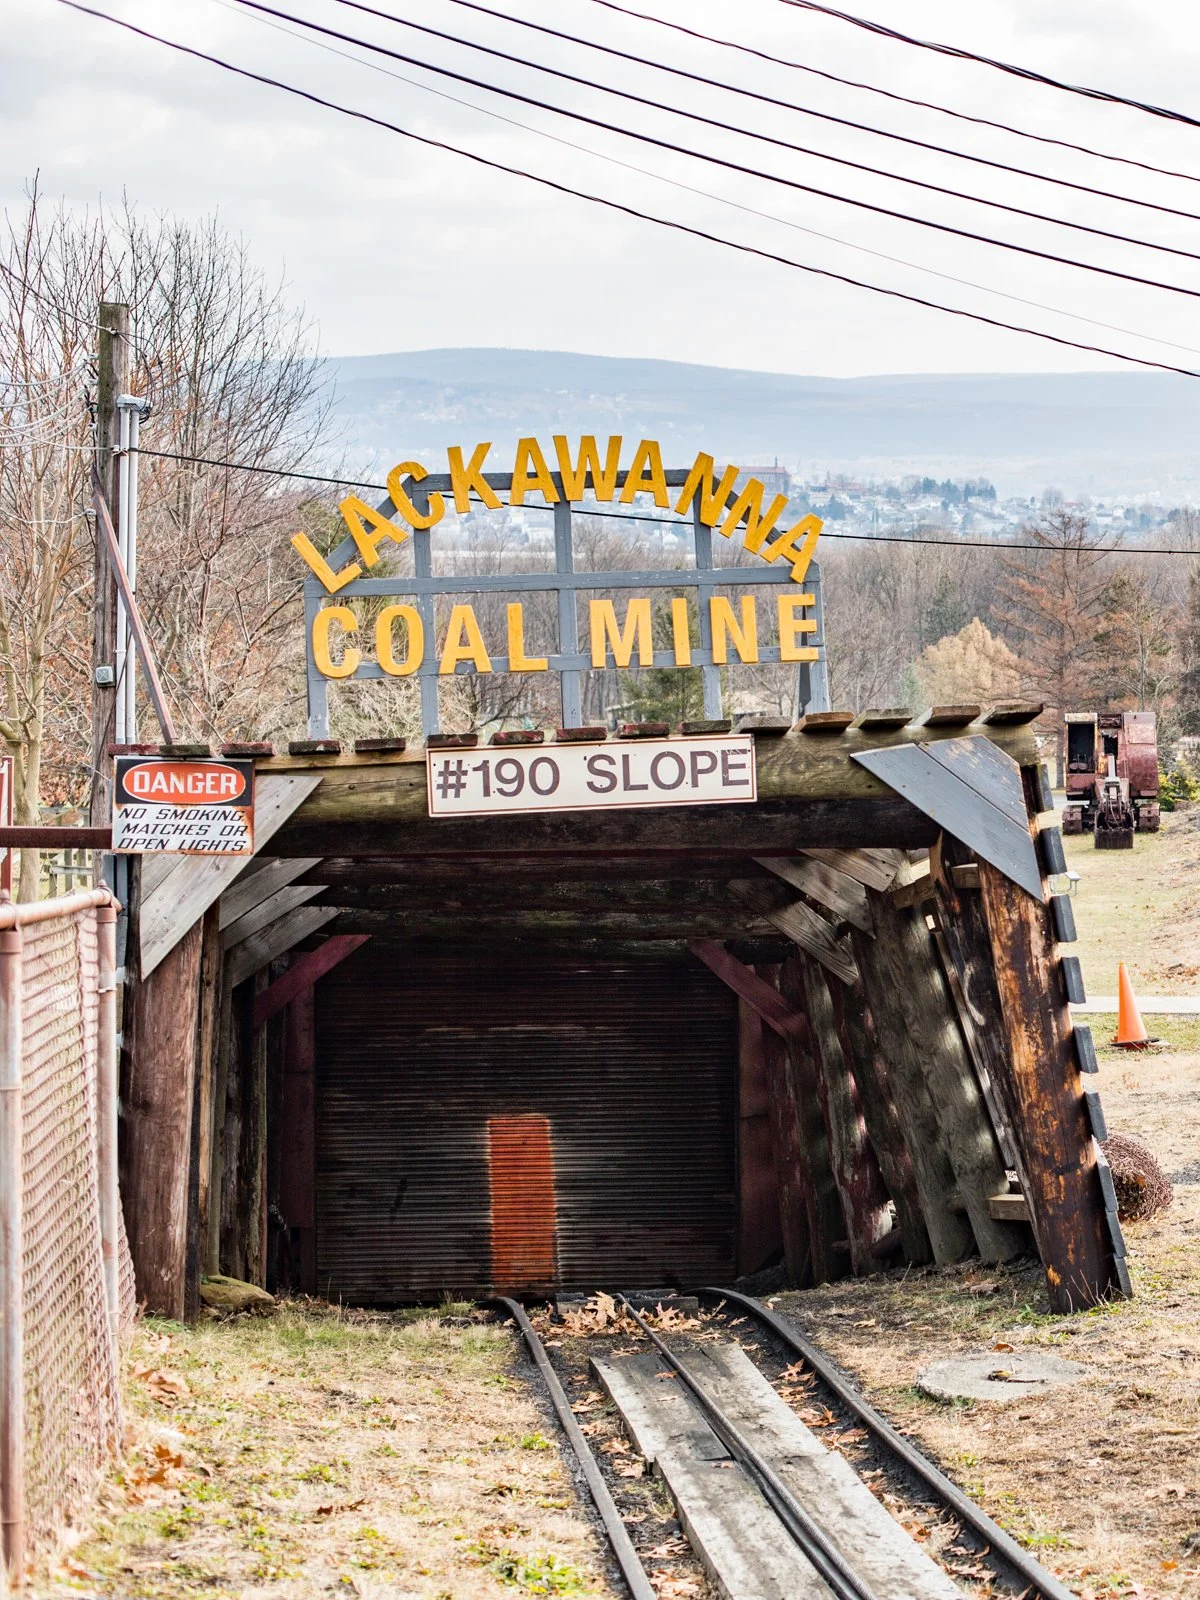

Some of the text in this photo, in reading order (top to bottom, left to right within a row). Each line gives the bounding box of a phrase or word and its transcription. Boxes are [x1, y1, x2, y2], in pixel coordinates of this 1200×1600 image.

[290, 435, 824, 593] LACKAWANNA
[312, 594, 819, 679] COAL MINE
[133, 771, 237, 795] DANGER
[436, 748, 749, 799] #190 SLOPE
[118, 808, 147, 819] NO
[121, 823, 248, 837] MATCHES OR
[117, 837, 247, 852] OPEN LIGHTS
